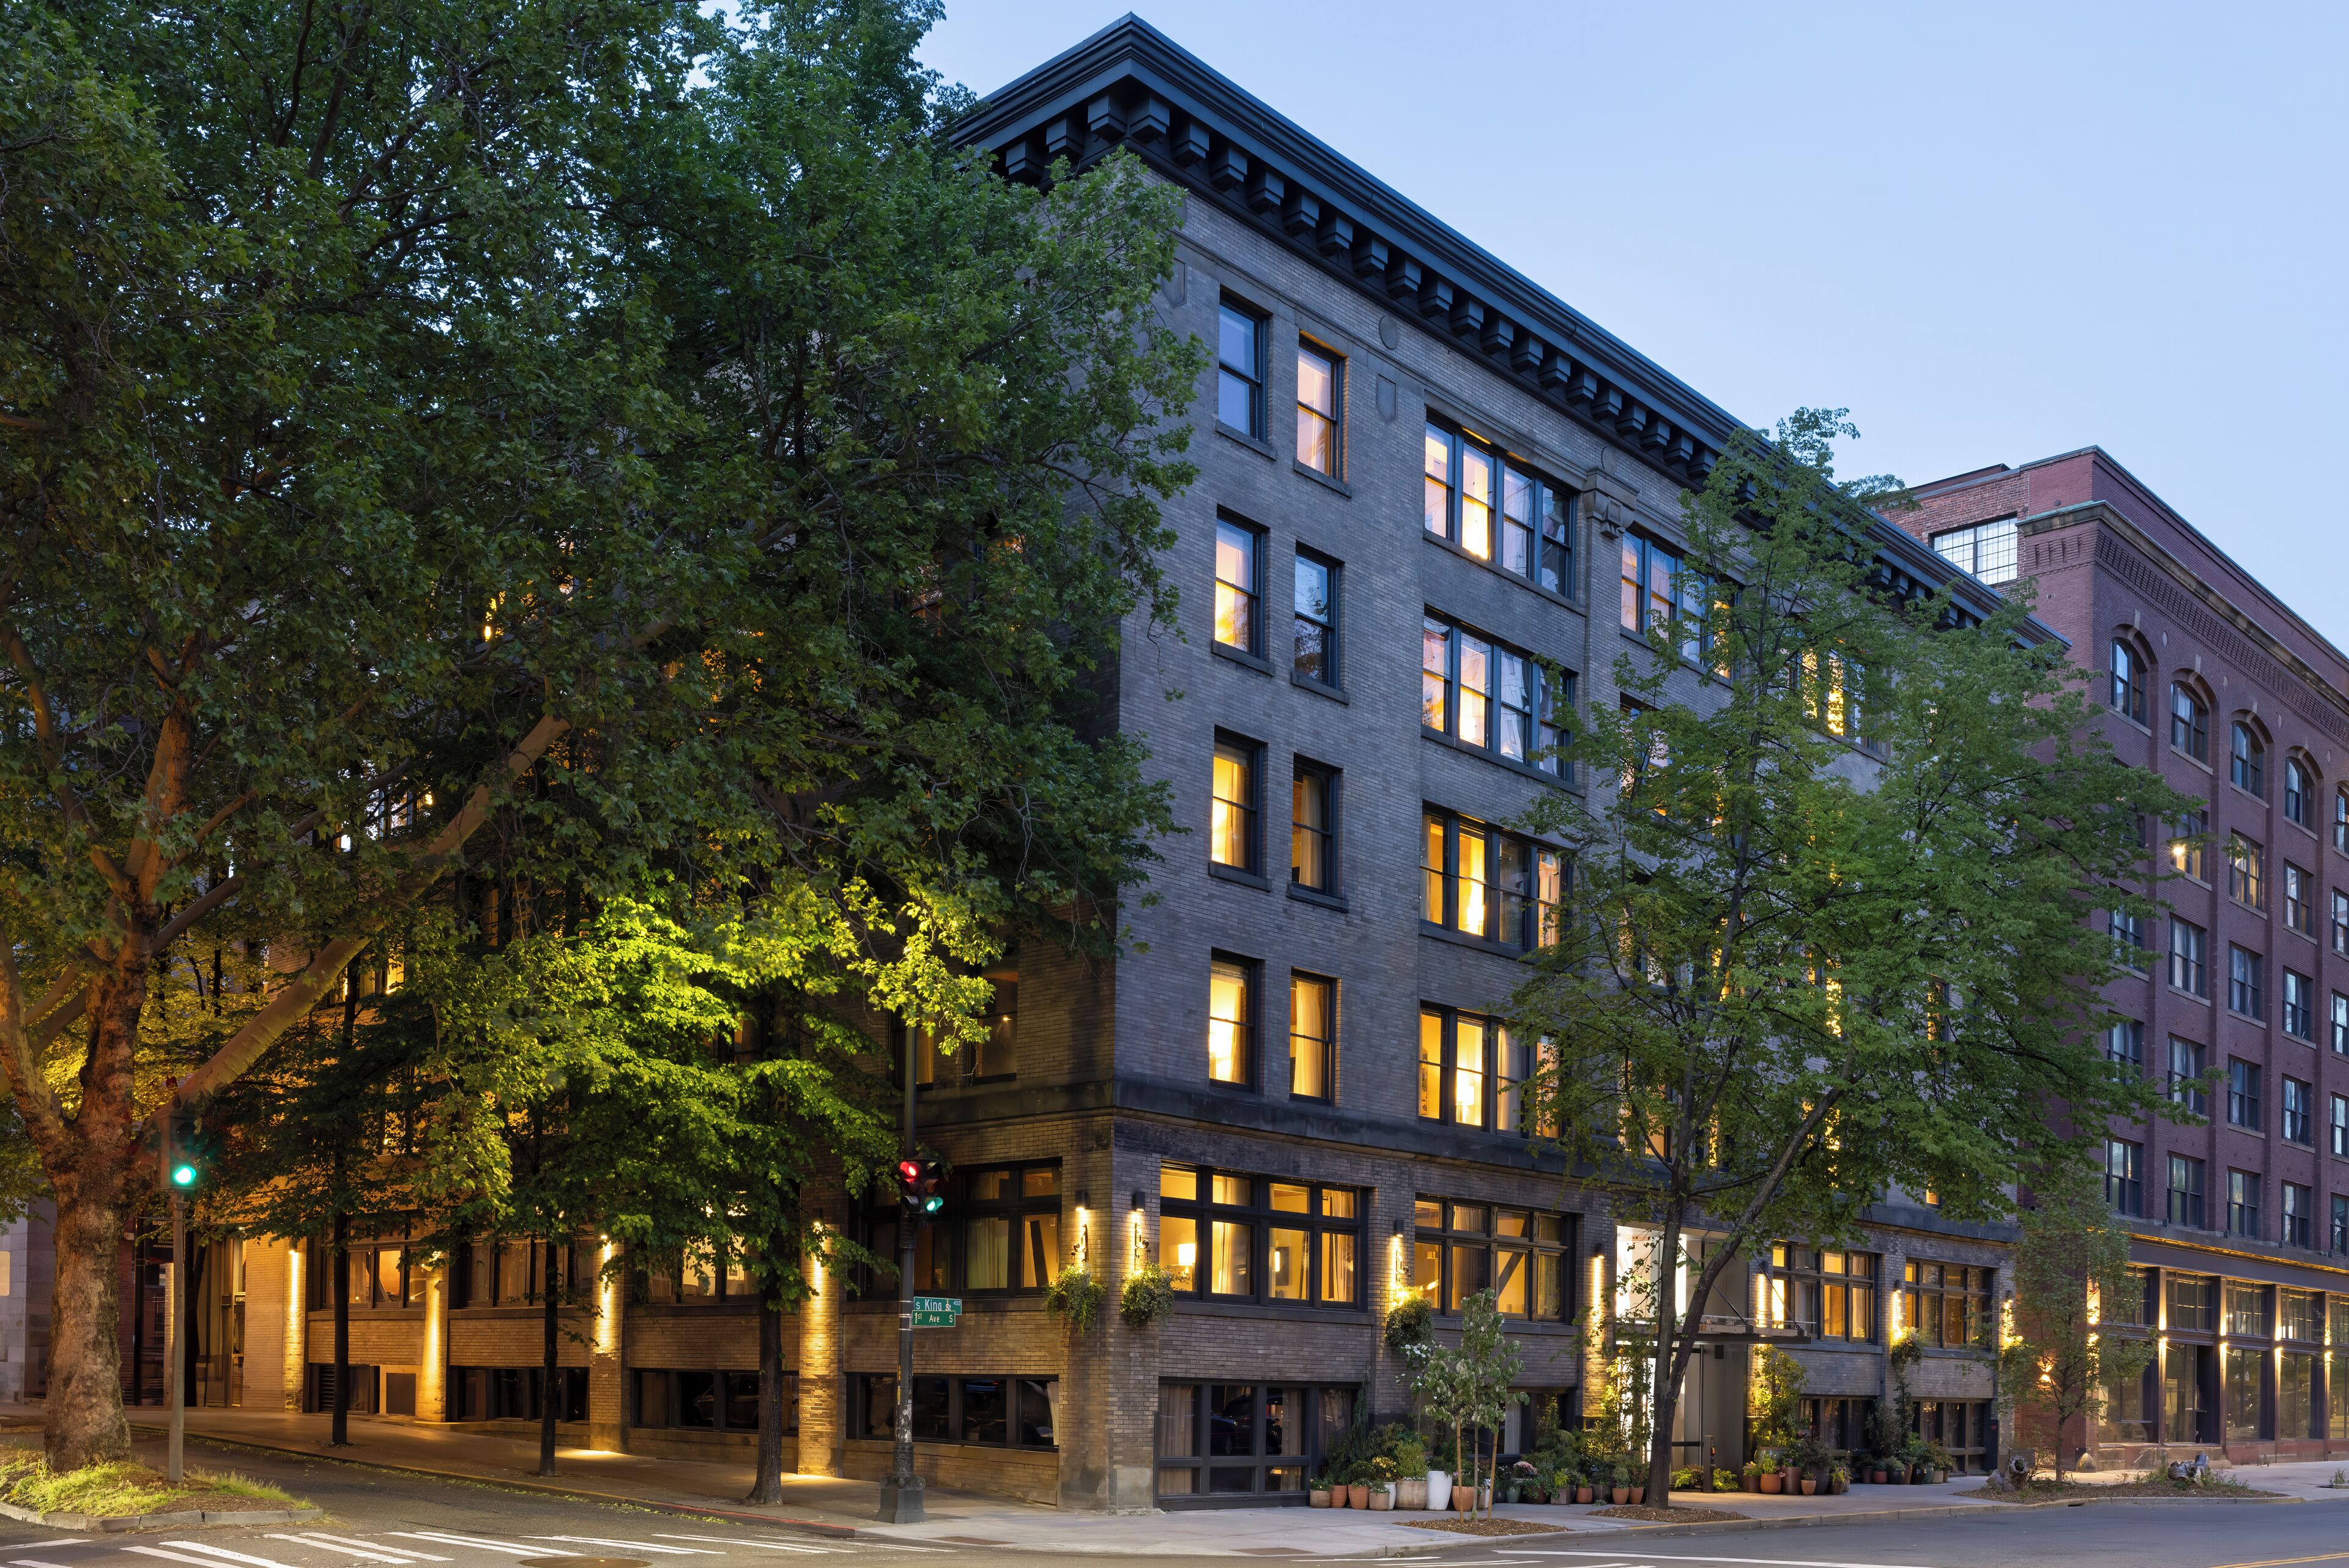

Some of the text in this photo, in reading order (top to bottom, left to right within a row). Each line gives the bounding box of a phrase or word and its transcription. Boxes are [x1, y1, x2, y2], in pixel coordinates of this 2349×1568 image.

[924, 1299, 942, 1310] King
[914, 1312, 953, 1324] 1st Ave S
